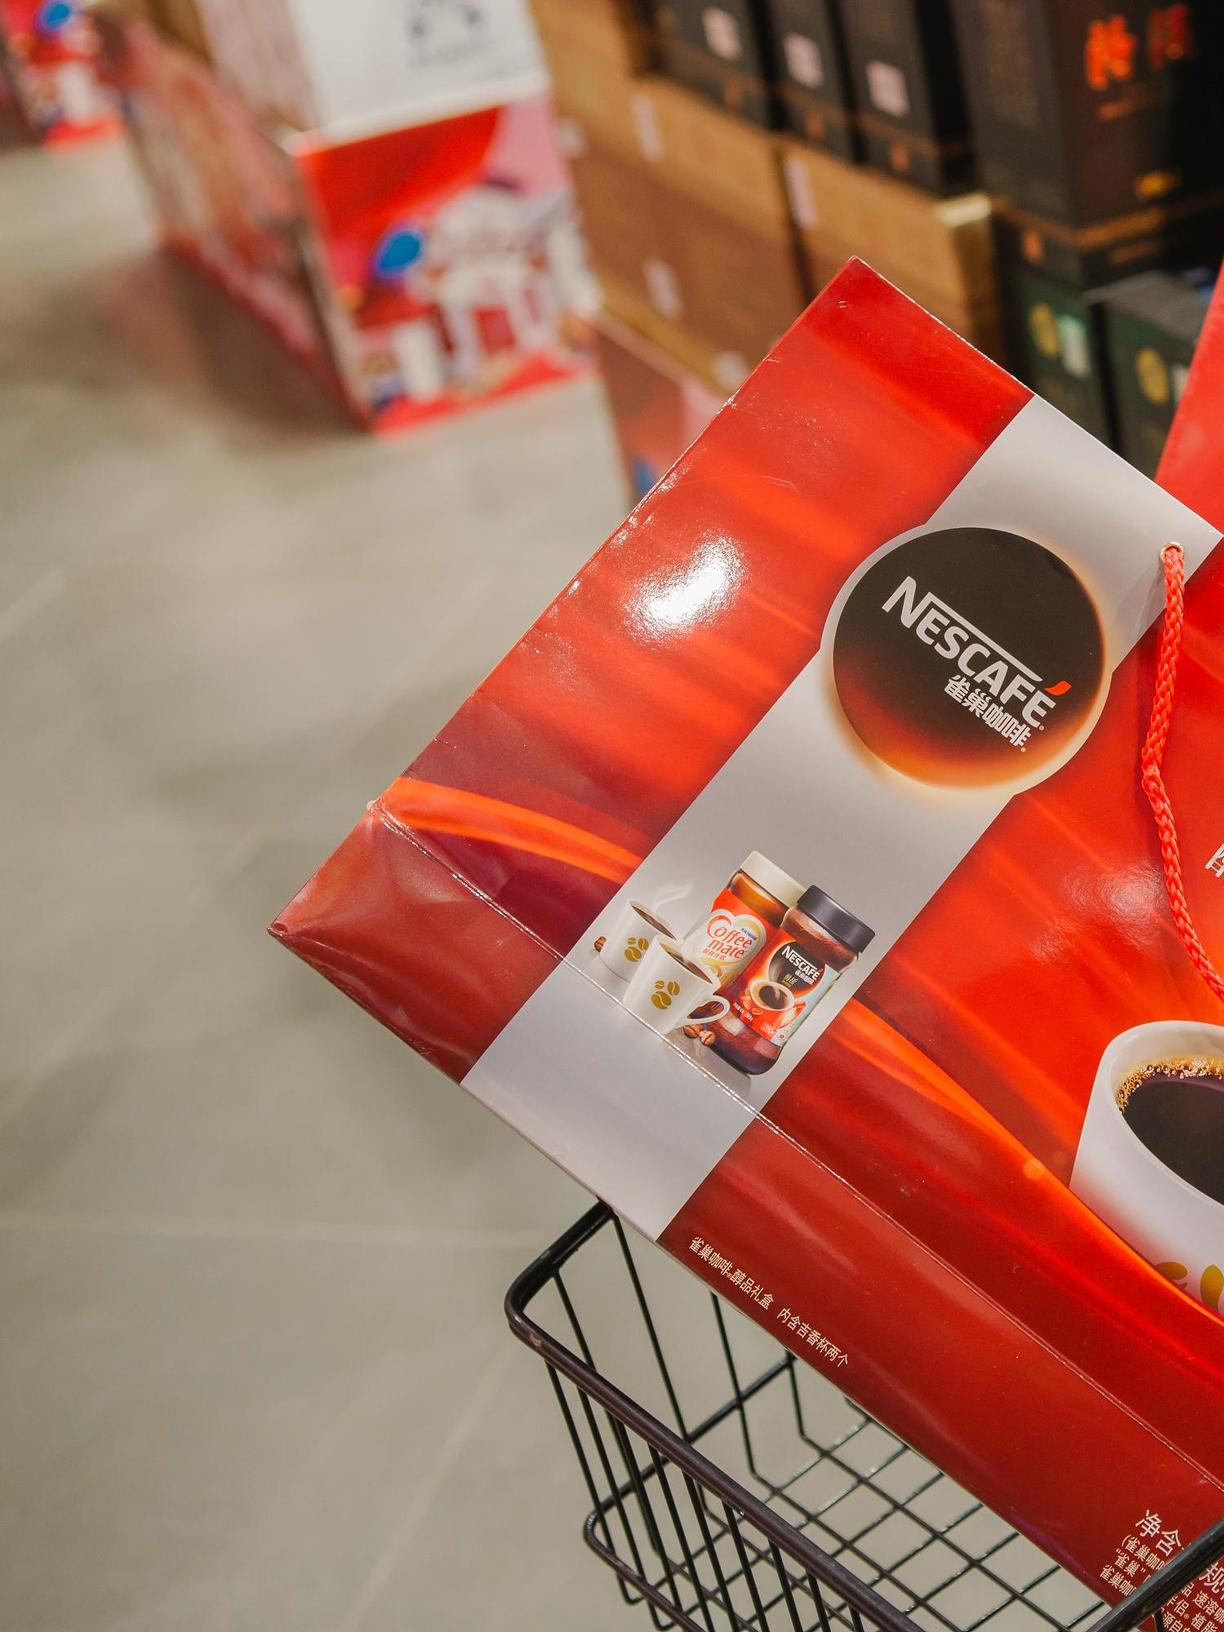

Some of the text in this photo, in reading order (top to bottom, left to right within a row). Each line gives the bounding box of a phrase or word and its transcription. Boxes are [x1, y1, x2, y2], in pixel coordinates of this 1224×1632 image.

[944, 673, 1032, 748] 雀巢咖啡
[706, 914, 753, 948] Coffee
[707, 939, 745, 959] mate
[776, 1307, 849, 1367] 内含吉香杯两个
[1135, 1509, 1184, 1557] 净含
[1100, 1564, 1137, 1597] 雀巢咖
